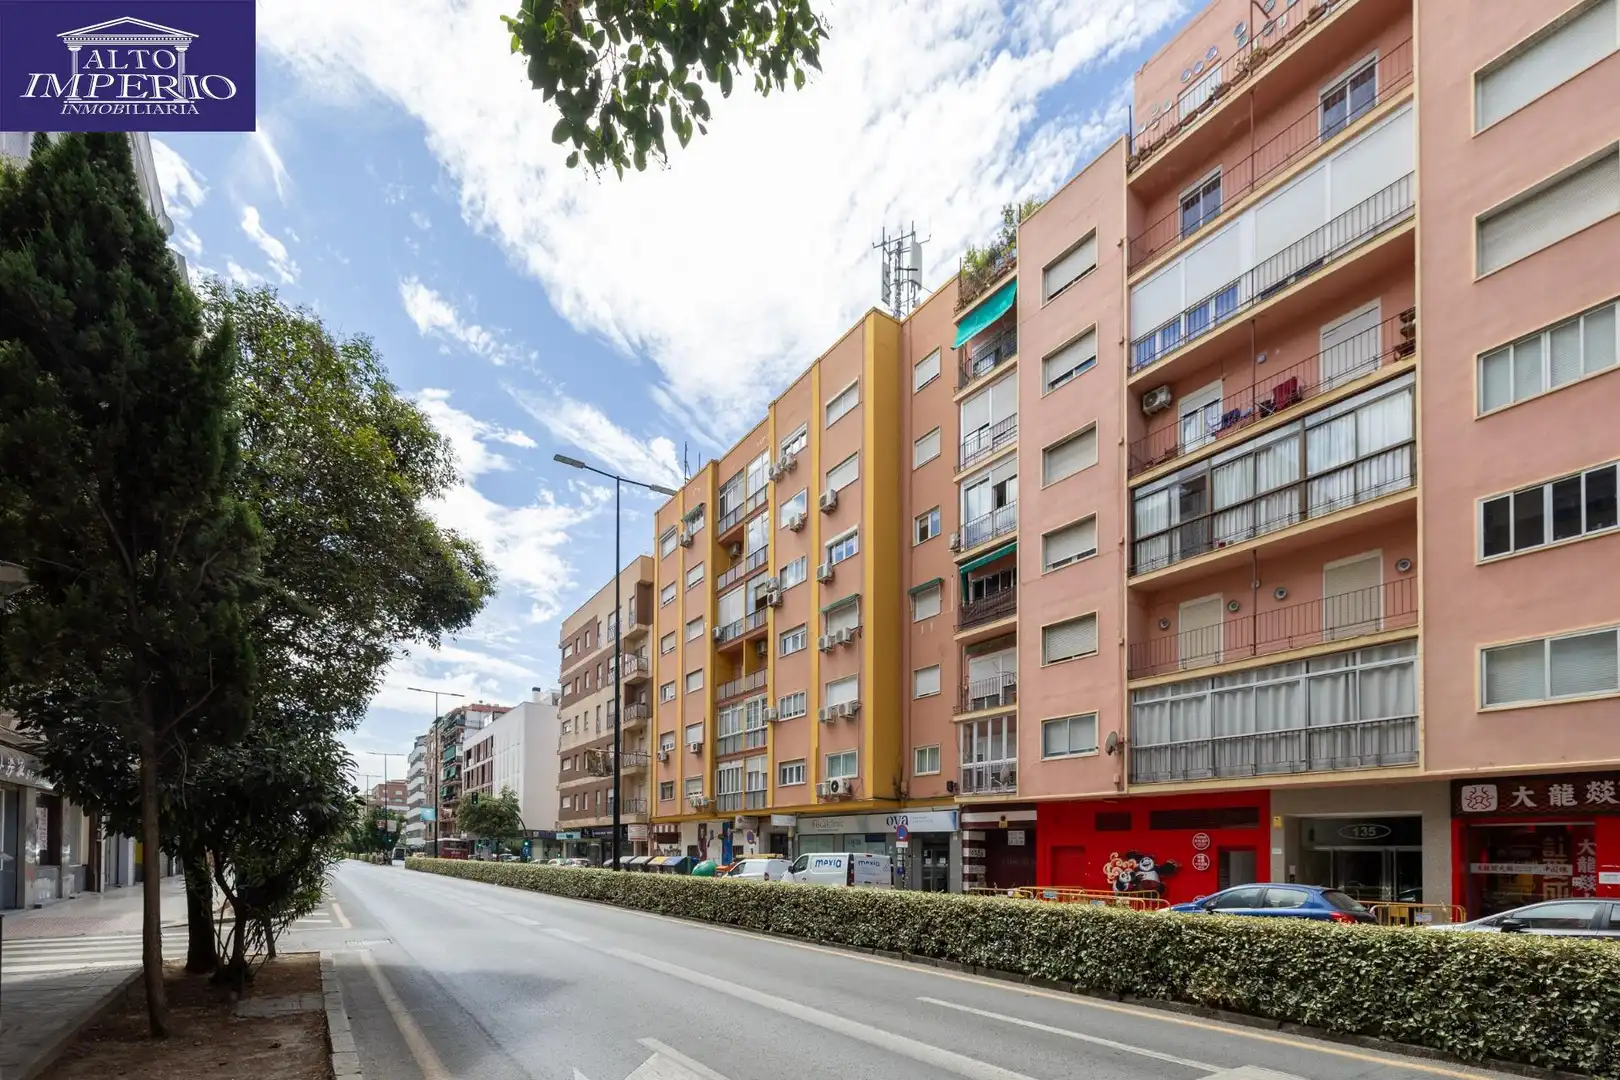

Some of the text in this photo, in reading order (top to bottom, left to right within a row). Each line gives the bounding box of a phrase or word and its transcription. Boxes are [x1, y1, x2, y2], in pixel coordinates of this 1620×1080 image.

[1352, 826, 1377, 837] 135
[1576, 839, 1597, 897] 大龍燚
